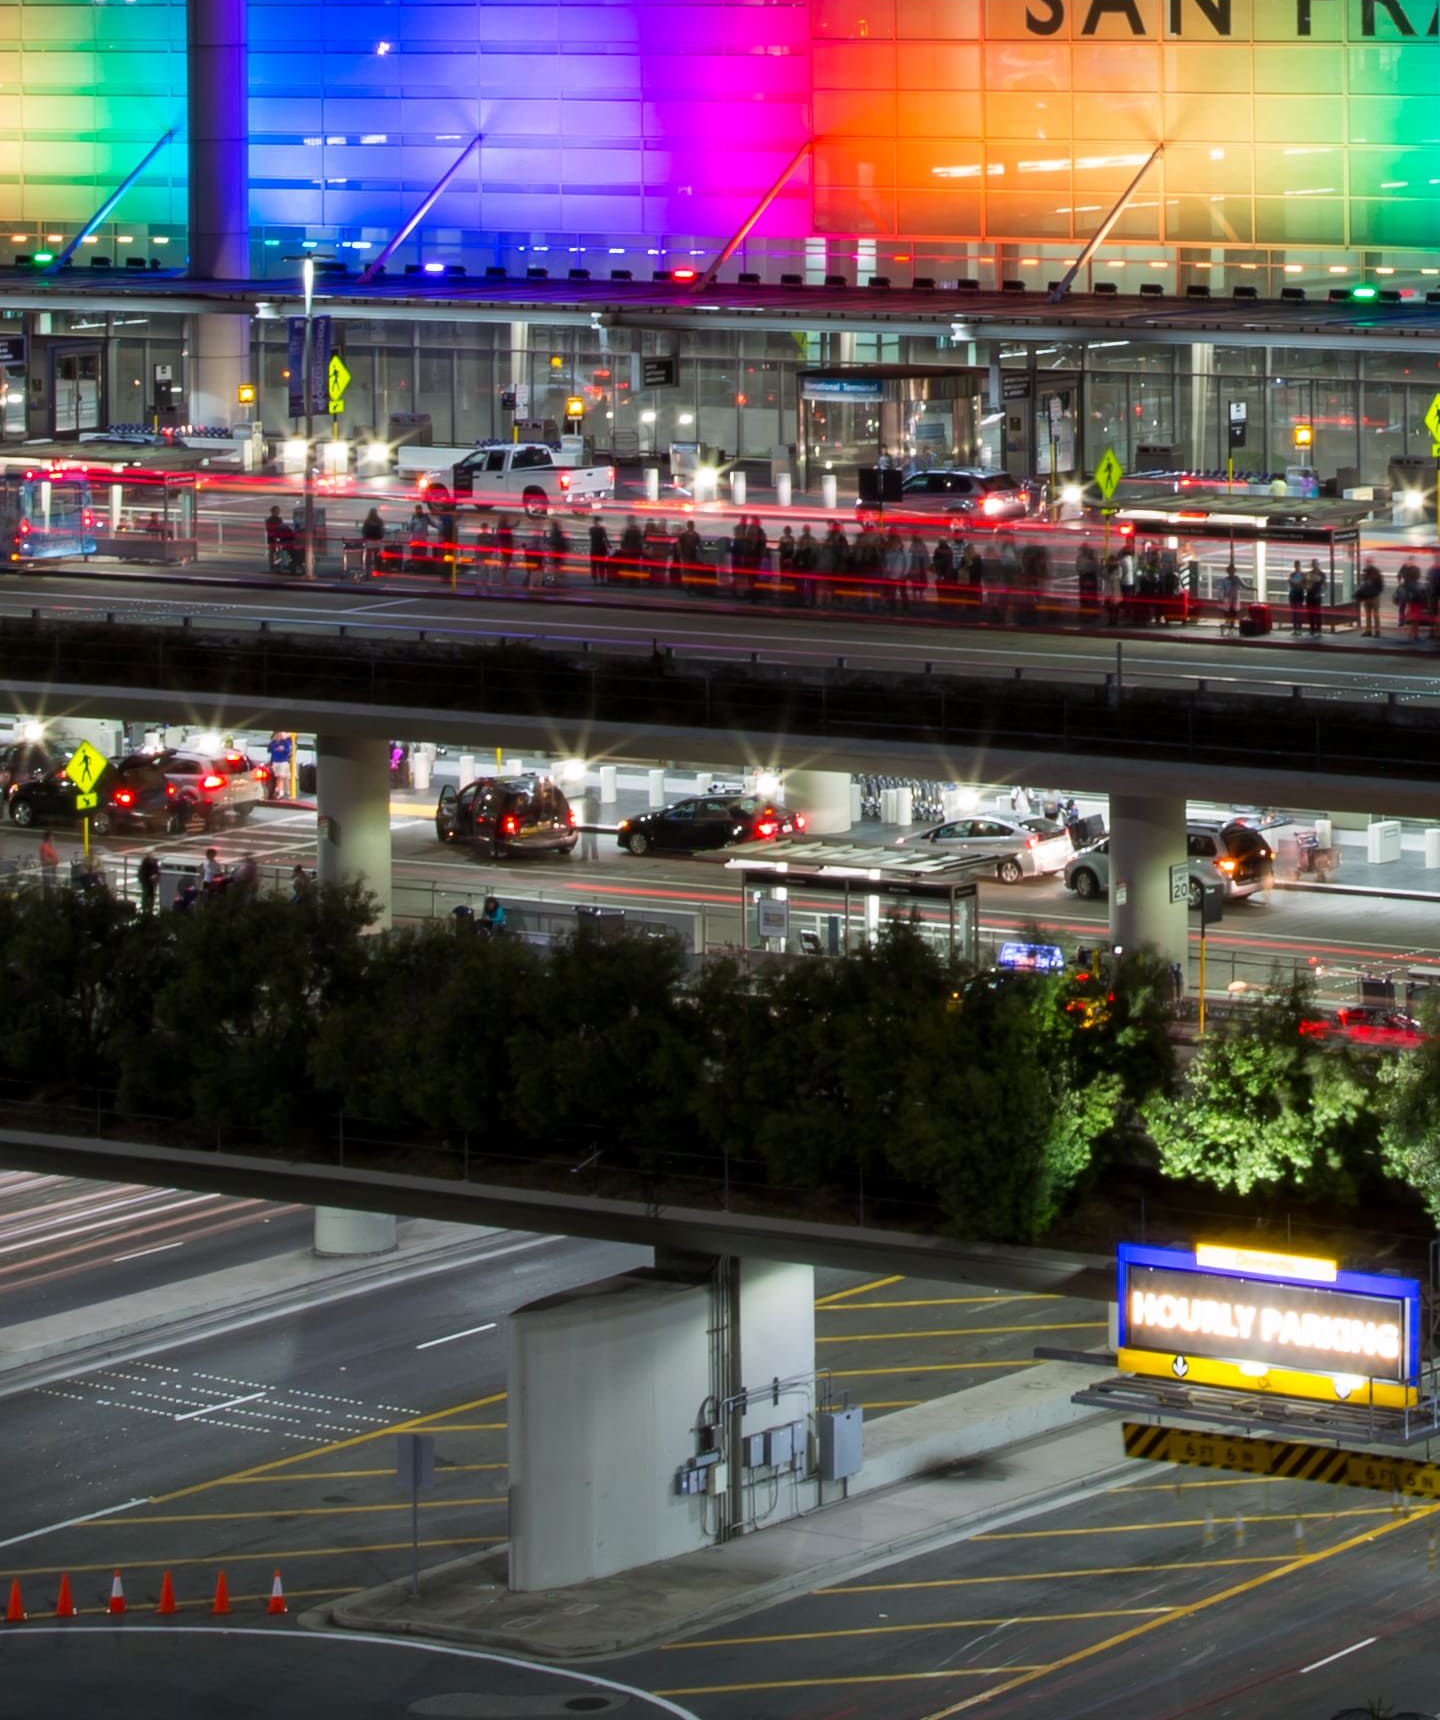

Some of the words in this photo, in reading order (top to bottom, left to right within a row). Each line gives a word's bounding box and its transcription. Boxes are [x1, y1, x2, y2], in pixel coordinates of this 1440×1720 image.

[1174, 883, 1188, 898] 20
[1132, 1290, 1257, 1340] HOURLY
[1261, 1308, 1400, 1360] PARKING
[1185, 1442, 1196, 1457] 6
[1200, 1445, 1214, 1458] FT
[1226, 1448, 1236, 1463] 6
[1365, 1466, 1375, 1480] 6
[1406, 1473, 1417, 1488] 6
